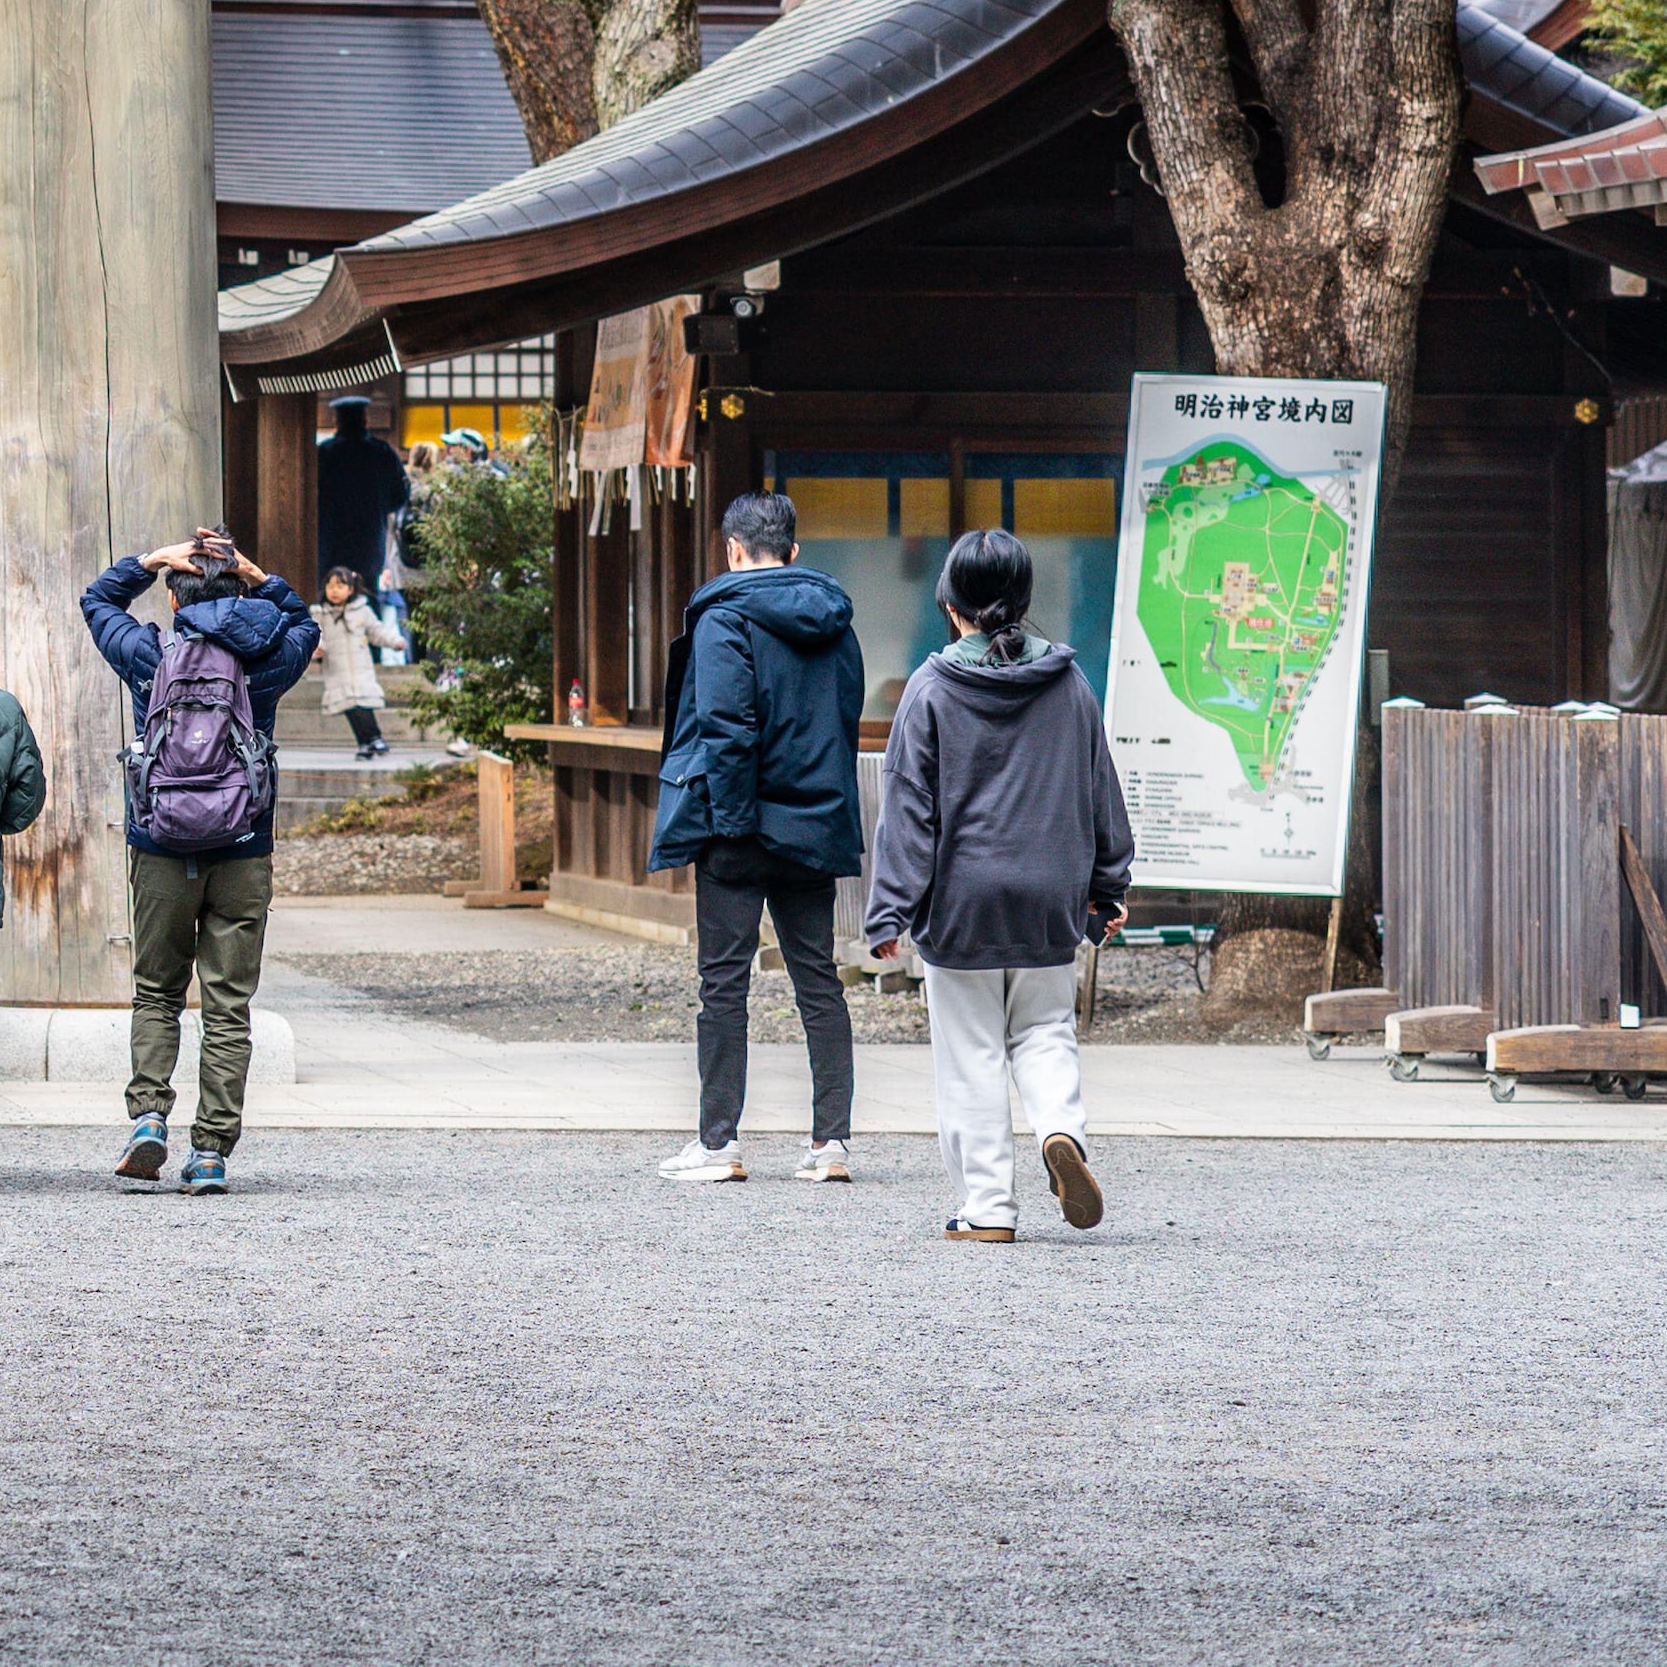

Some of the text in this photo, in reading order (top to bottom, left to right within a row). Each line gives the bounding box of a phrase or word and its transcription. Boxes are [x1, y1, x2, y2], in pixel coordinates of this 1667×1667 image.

[1174, 392, 1355, 425] 明治神宮境内図
